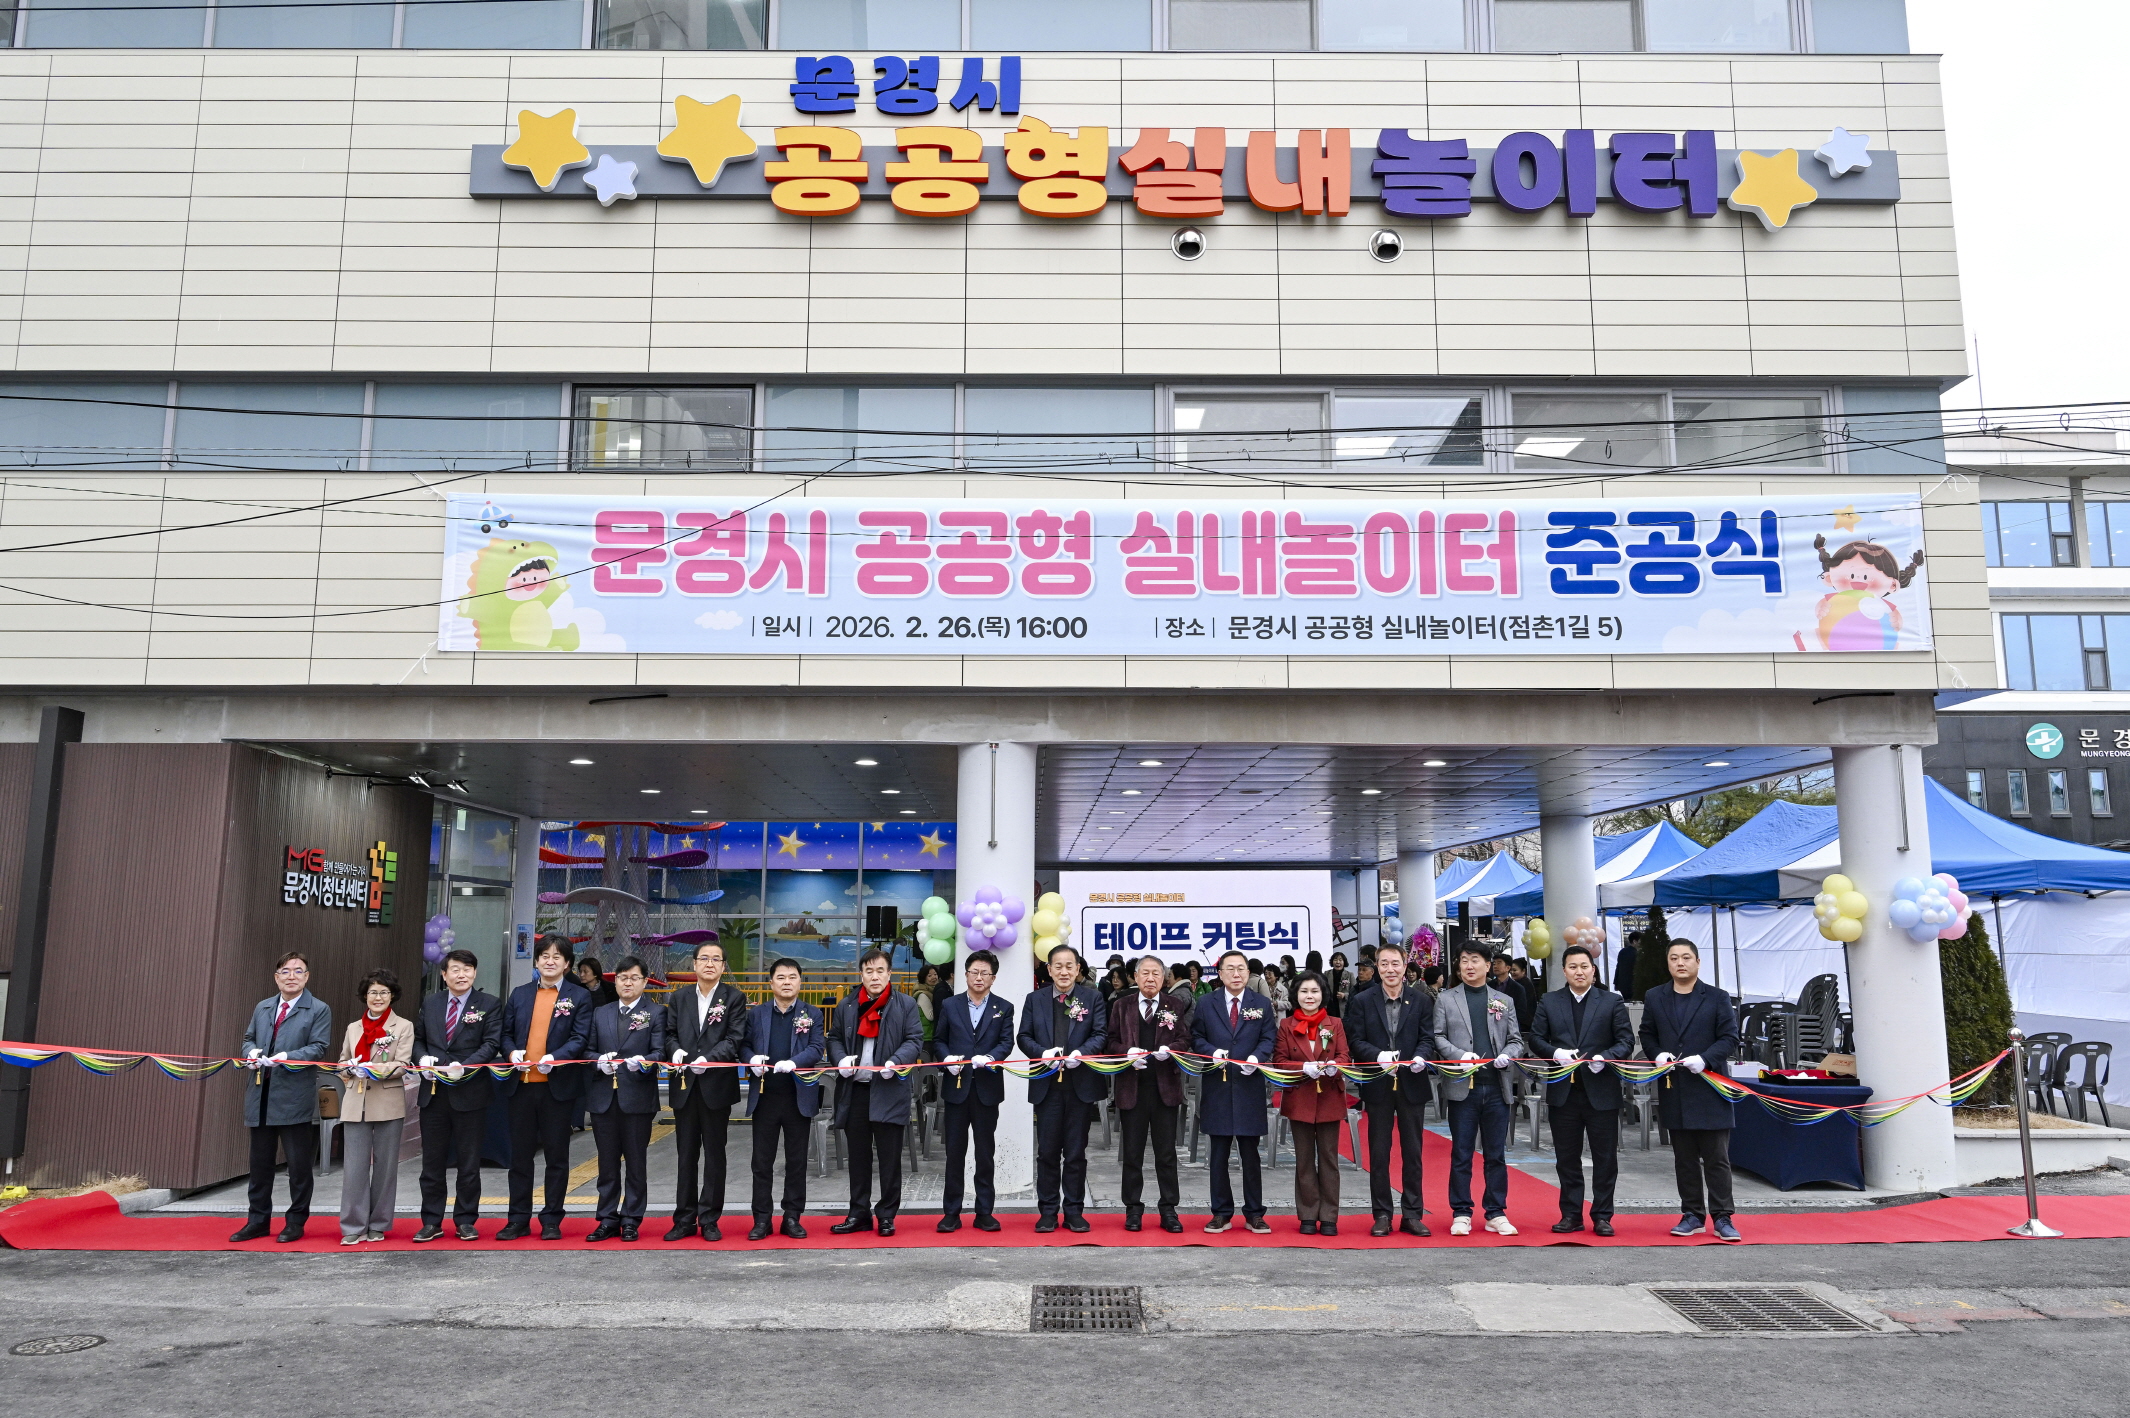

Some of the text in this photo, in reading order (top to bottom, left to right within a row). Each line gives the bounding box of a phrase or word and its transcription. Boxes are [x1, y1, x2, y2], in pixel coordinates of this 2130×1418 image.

[789, 55, 1022, 116] 문경시
[591, 509, 1787, 596] 문경시 공공형 실내놀이터 준공식
[762, 615, 801, 639] 일시
[825, 617, 895, 639] 2026.
[906, 617, 928, 639] 2.
[1165, 617, 1206, 638] 장소
[1228, 615, 1297, 640] 문경시
[1304, 615, 1374, 640] 공공형
[1598, 616, 1623, 640] 5)
[288, 845, 325, 872] MG
[284, 871, 369, 909] 문경시청년센터
[1089, 892, 1186, 904] 문경시 공공형 실내놀이터
[1094, 921, 1299, 951] 테이프 커팅식
